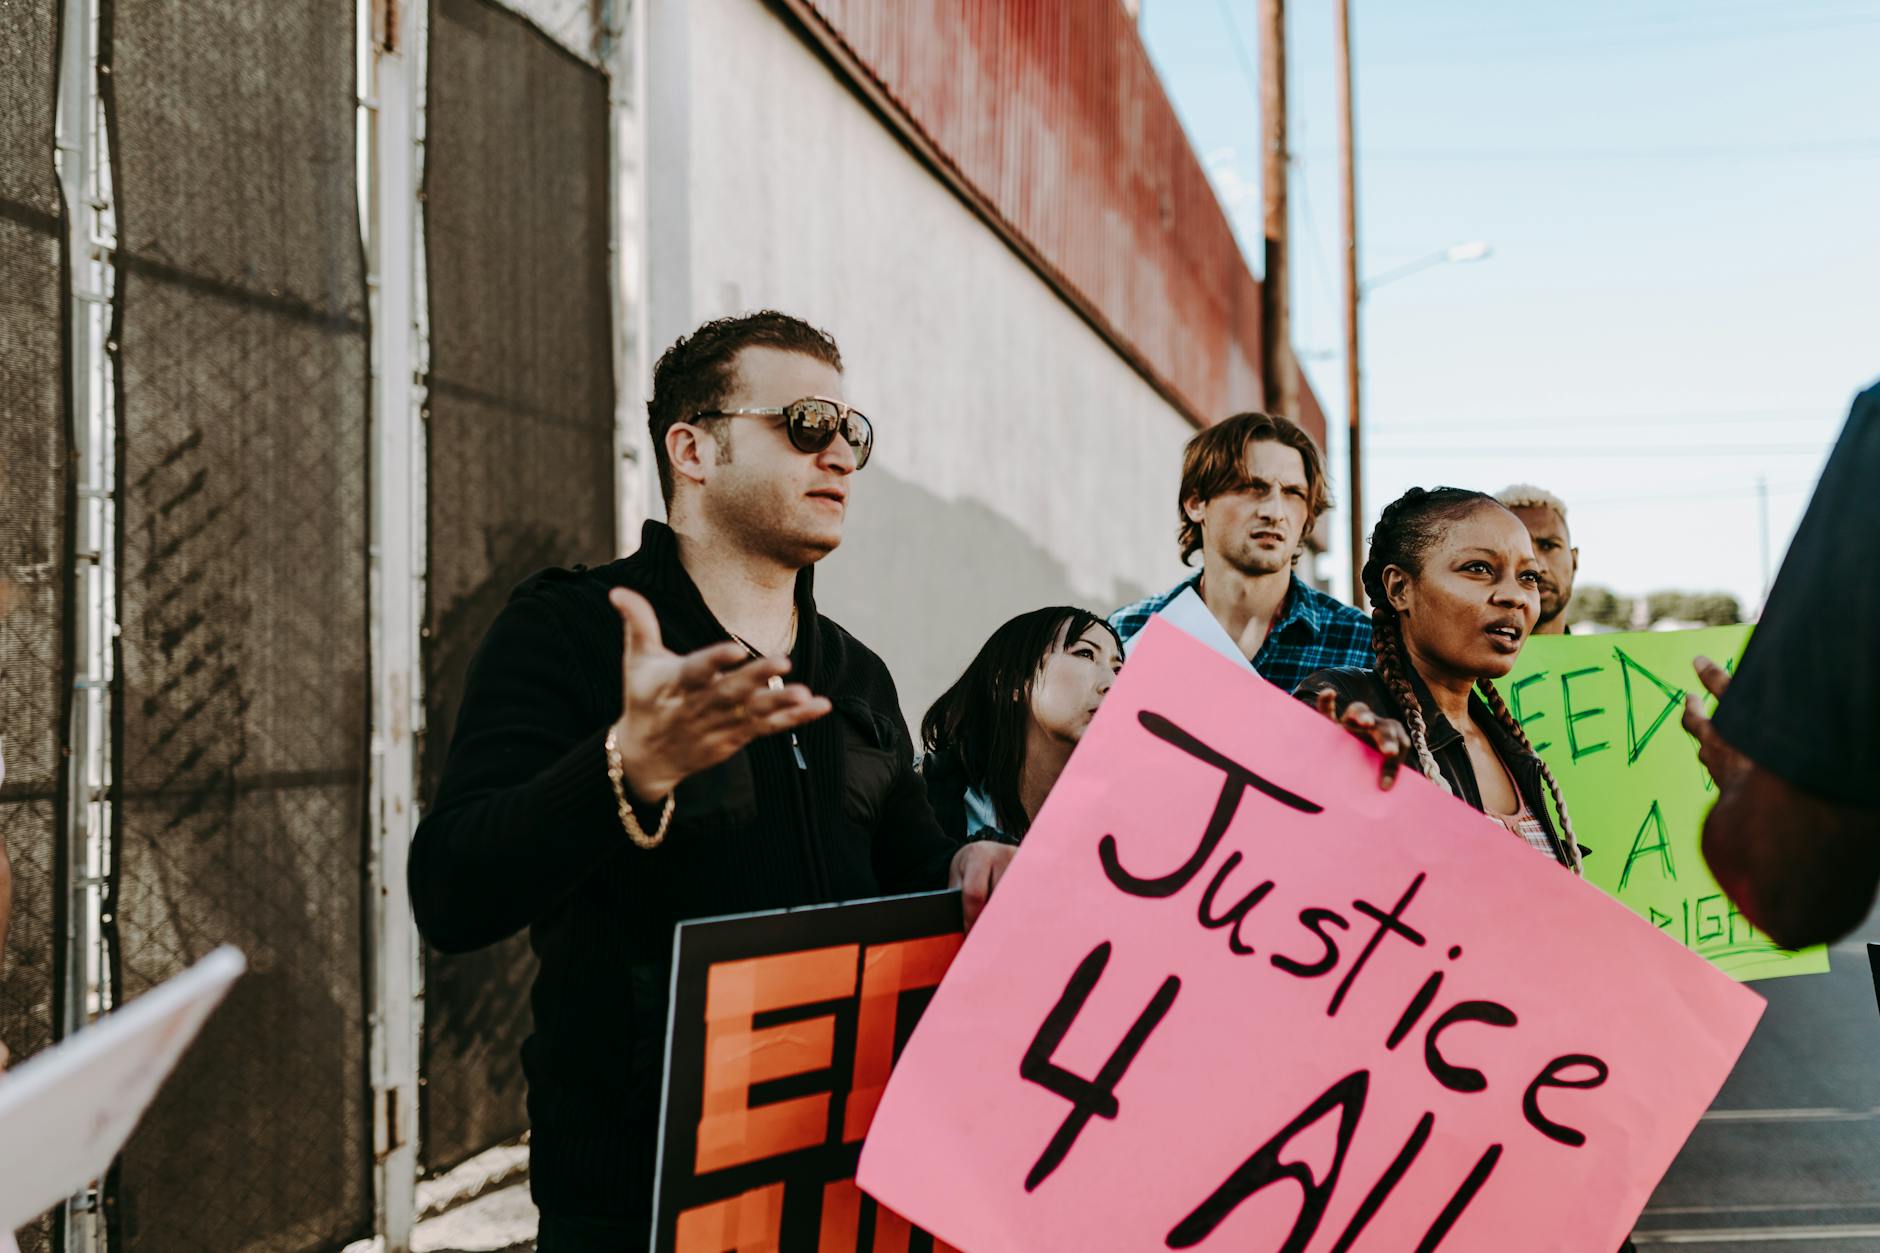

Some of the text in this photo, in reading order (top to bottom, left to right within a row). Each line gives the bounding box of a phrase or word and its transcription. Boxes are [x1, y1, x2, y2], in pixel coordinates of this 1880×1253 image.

[1098, 709, 1609, 1147] Justice
[1618, 799, 1677, 893] A
[1020, 941, 1503, 1253] 4 All
